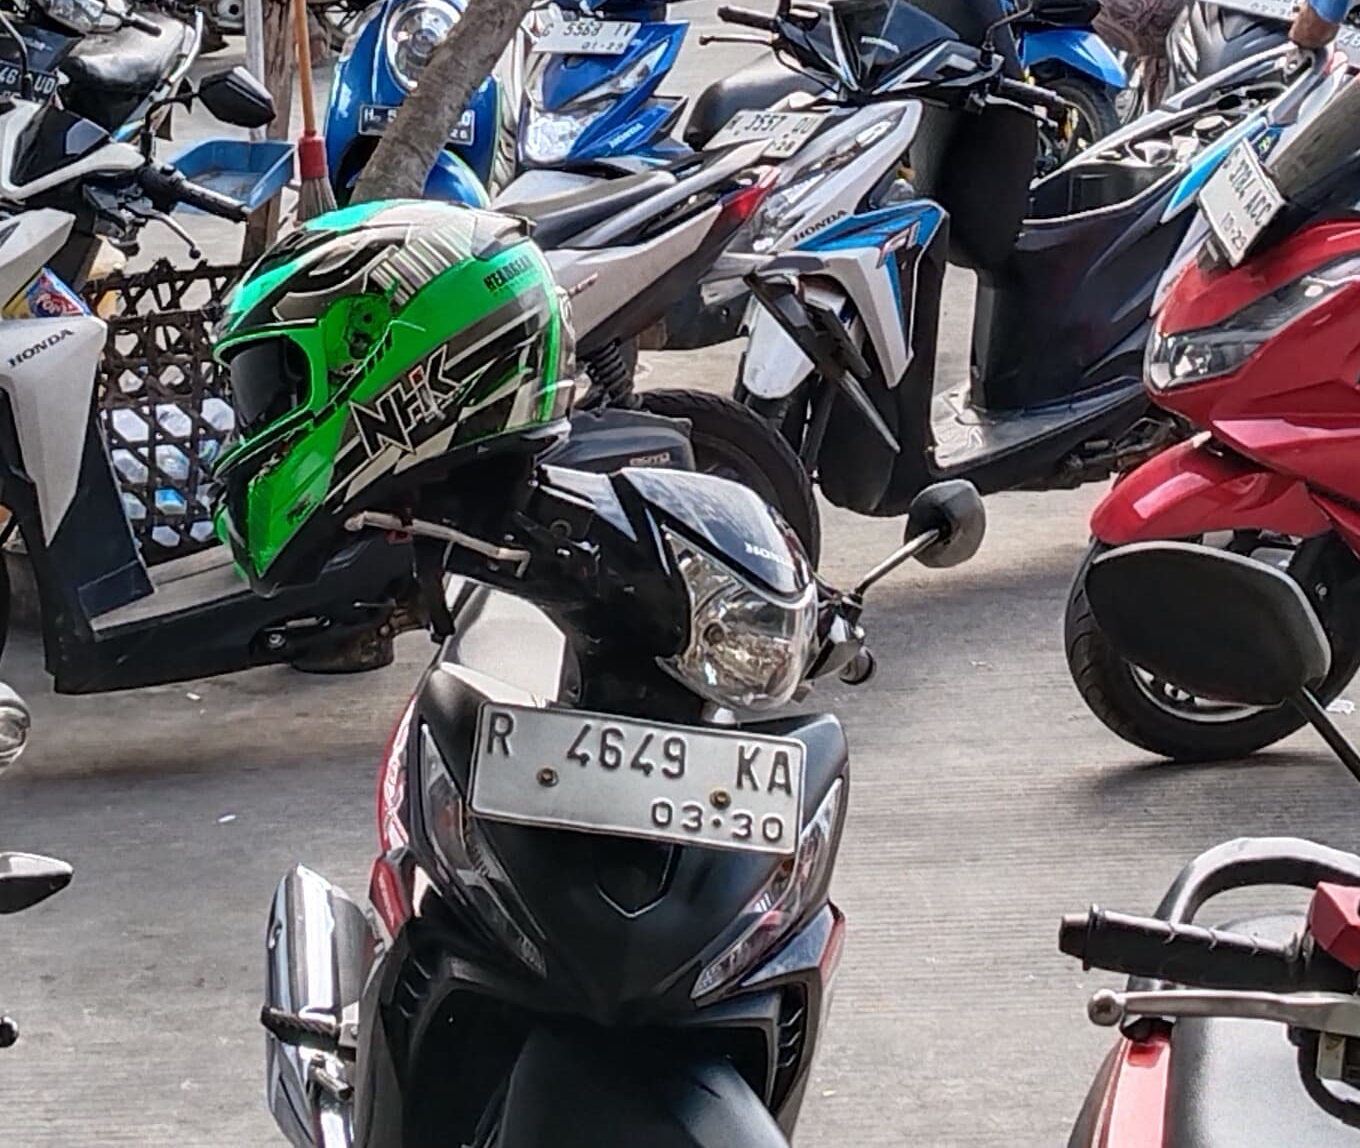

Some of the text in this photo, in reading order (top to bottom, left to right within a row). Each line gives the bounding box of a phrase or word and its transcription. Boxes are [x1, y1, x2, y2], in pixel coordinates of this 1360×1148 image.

[792, 208, 848, 243] HONDA
[7, 328, 75, 369] HONDA
[348, 343, 462, 461] NHK
[486, 713, 794, 797] R 4649 KA
